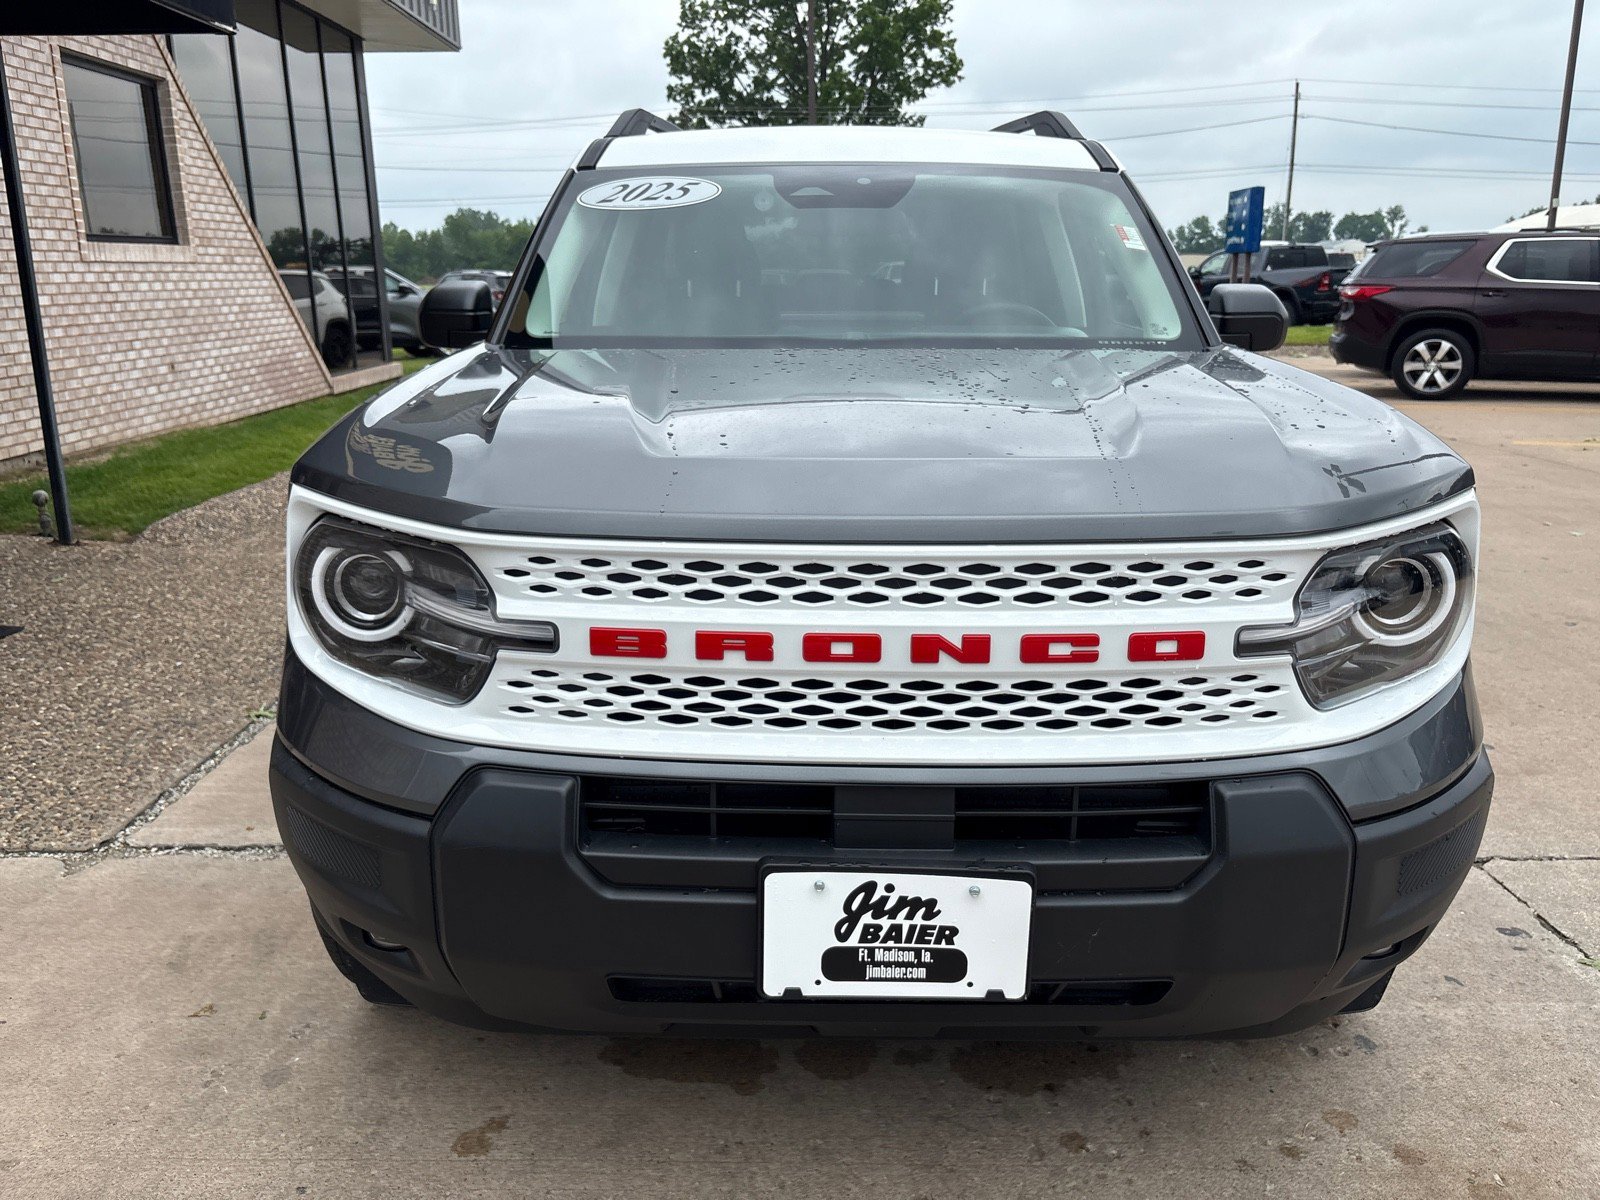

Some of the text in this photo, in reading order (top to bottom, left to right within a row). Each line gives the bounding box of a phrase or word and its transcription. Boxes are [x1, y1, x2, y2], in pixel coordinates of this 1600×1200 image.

[596, 182, 701, 204] 2025
[590, 627, 1205, 664] BRONCO
[834, 880, 941, 943] Jim
[858, 923, 960, 945] BAIER
[858, 948, 871, 962] Ft.
[874, 948, 918, 964] Madison,
[865, 964, 927, 980] jimbaier.com
